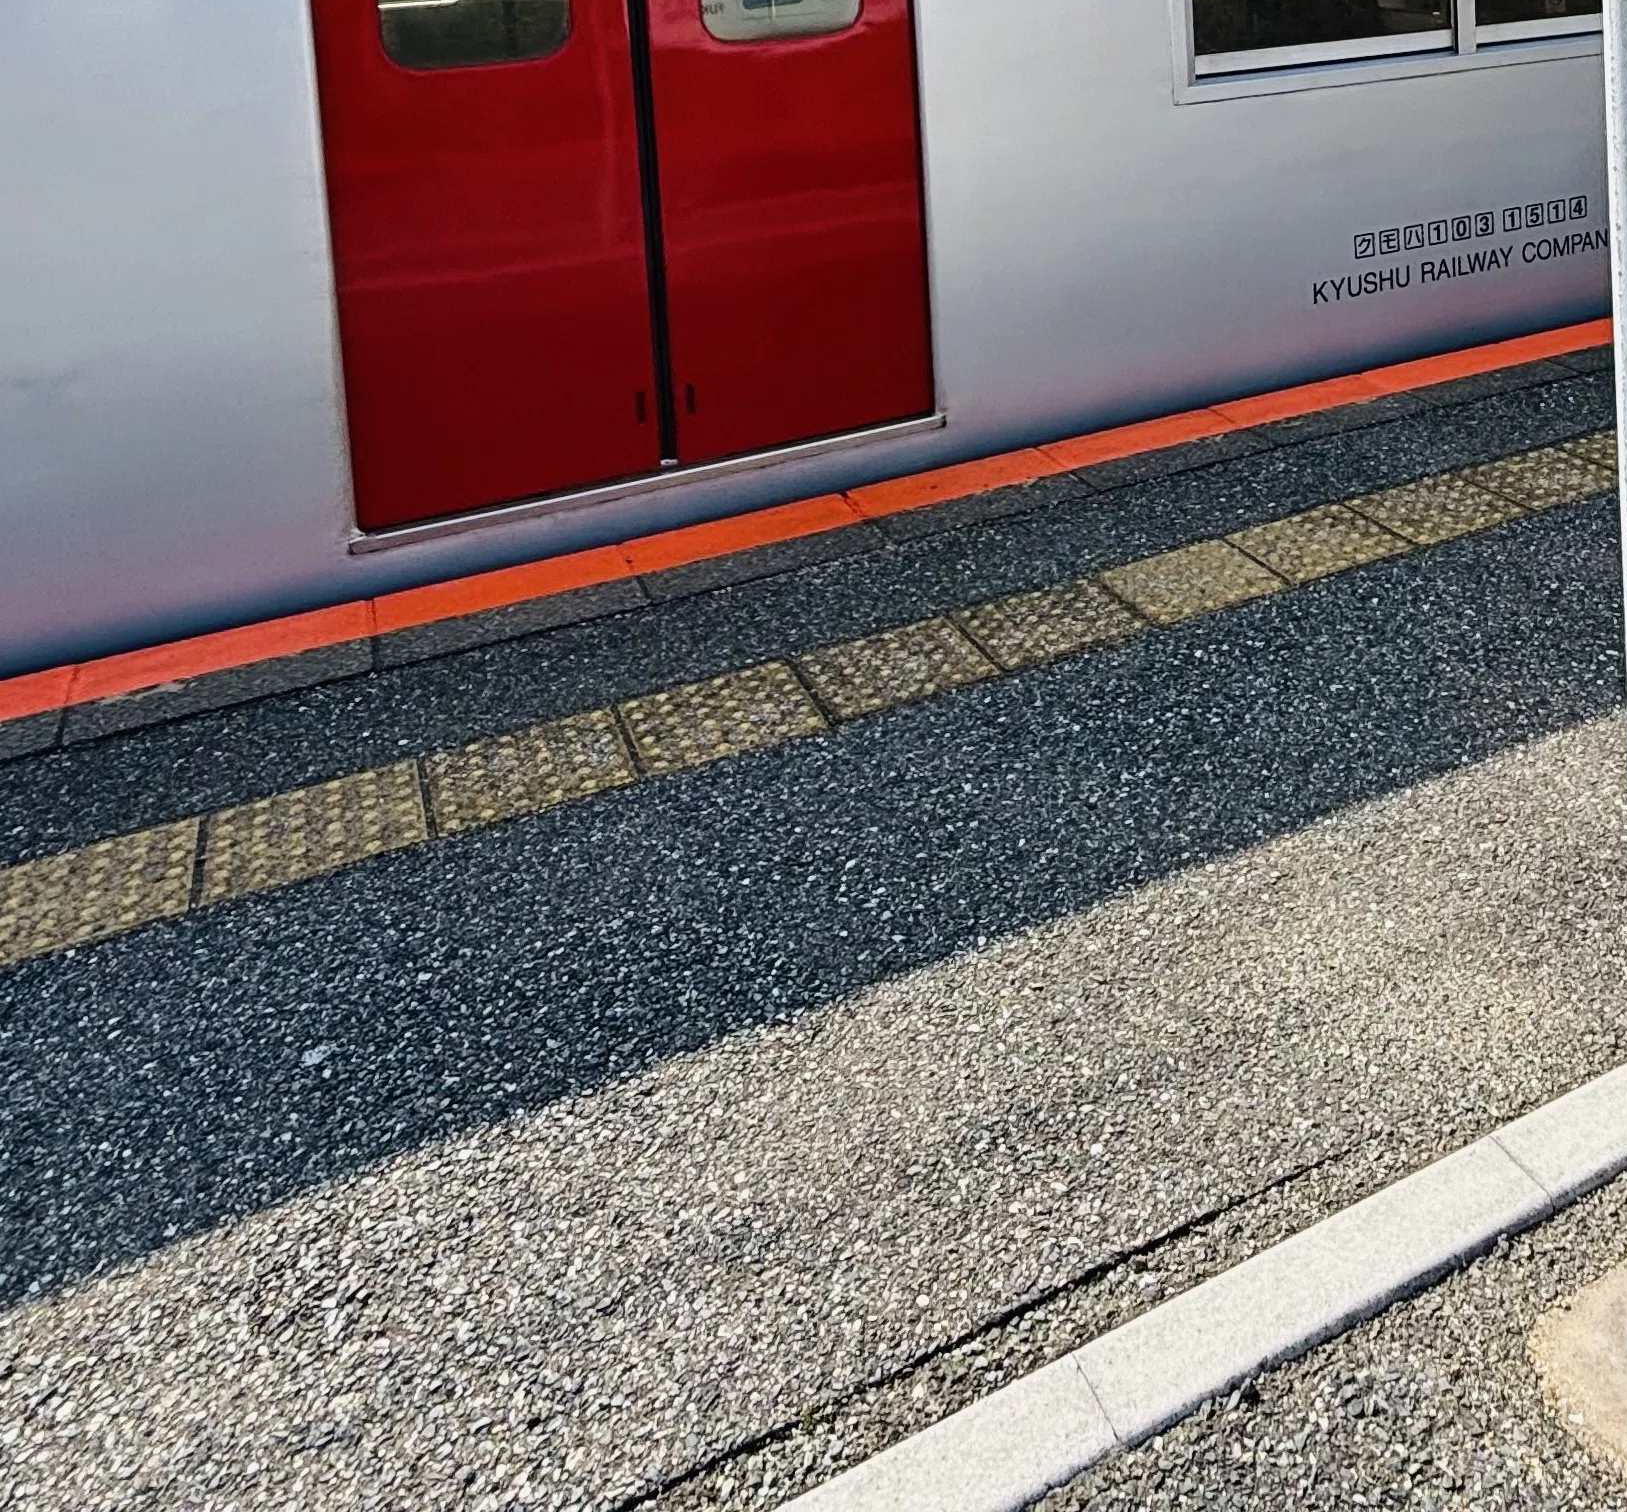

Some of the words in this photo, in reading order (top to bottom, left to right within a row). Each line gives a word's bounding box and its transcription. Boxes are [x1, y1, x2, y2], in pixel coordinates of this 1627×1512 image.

[1354, 211, 1495, 260] クモハ103
[1502, 195, 1588, 232] 1514
[1312, 266, 1411, 304] KYUSHU
[1420, 245, 1513, 284] RAILWAY
[1521, 228, 1609, 264] COMPAN
